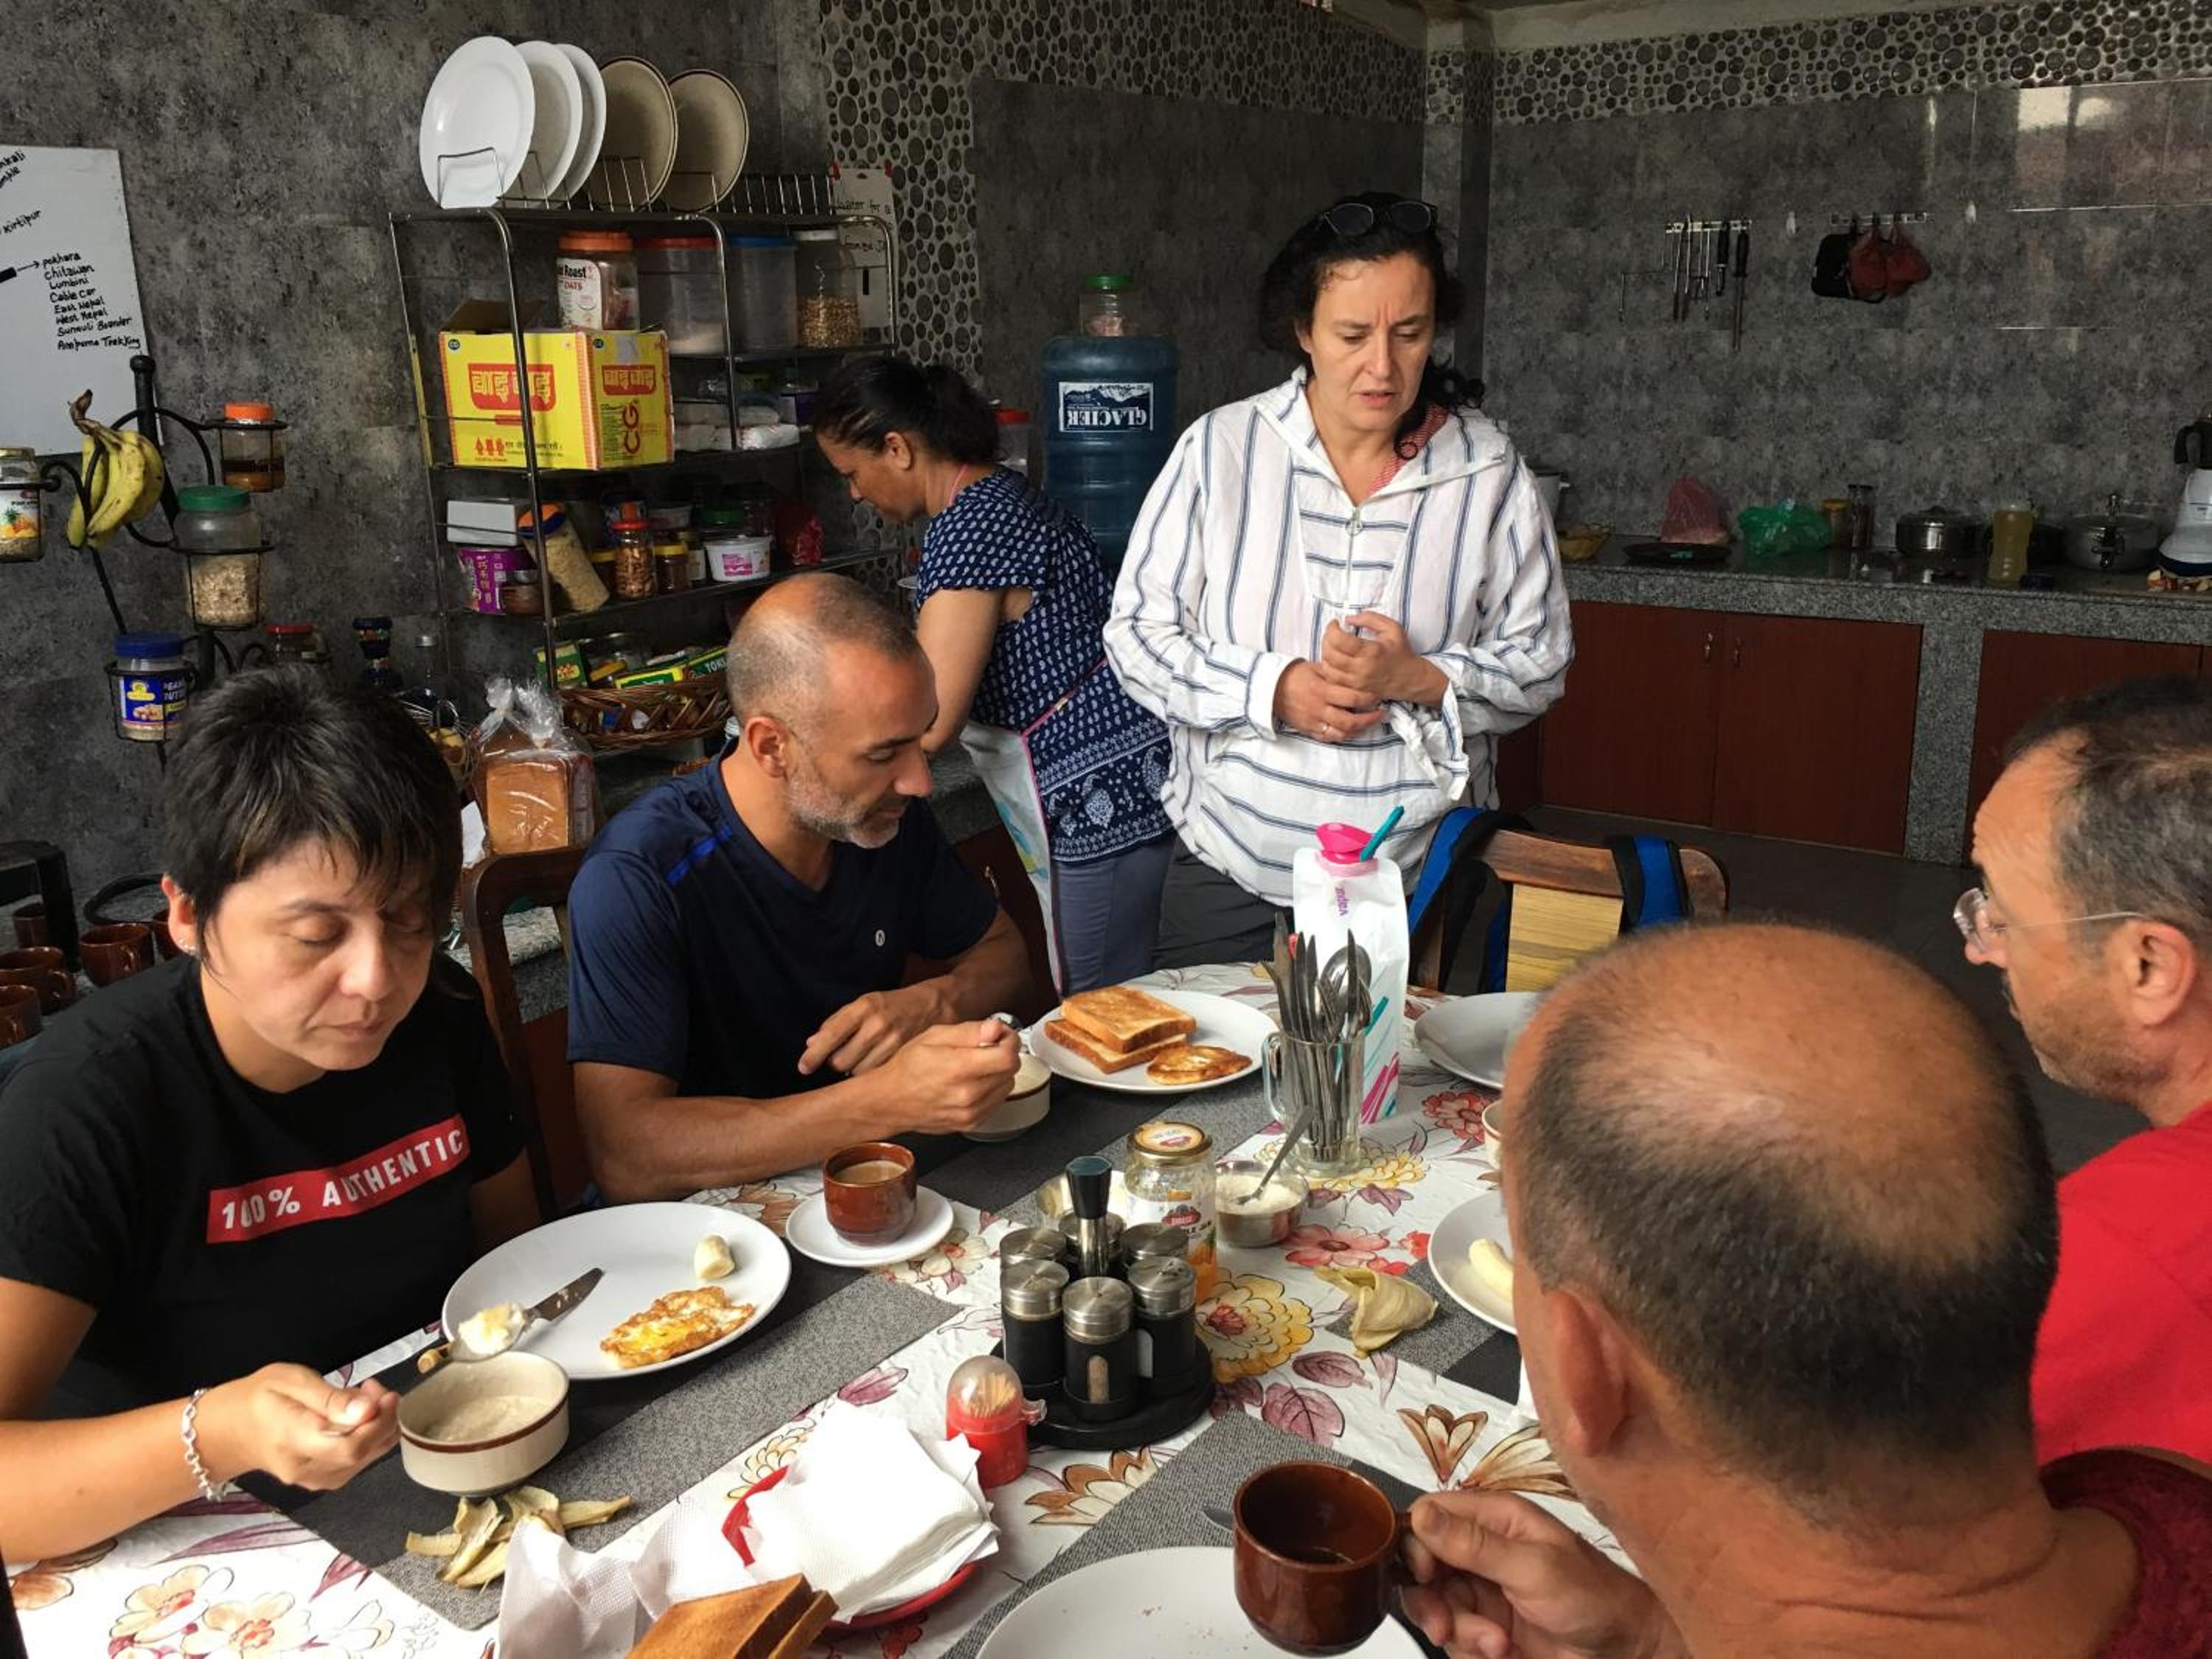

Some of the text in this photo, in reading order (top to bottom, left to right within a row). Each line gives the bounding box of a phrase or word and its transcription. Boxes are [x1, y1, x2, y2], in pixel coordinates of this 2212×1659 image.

[49, 274, 88, 289] Lumbini
[78, 296, 105, 309] Nepal
[80, 307, 108, 320] Nepal
[1067, 408, 1147, 426] GLACIER
[222, 1129, 465, 1230] 100% AUTHENTIC
